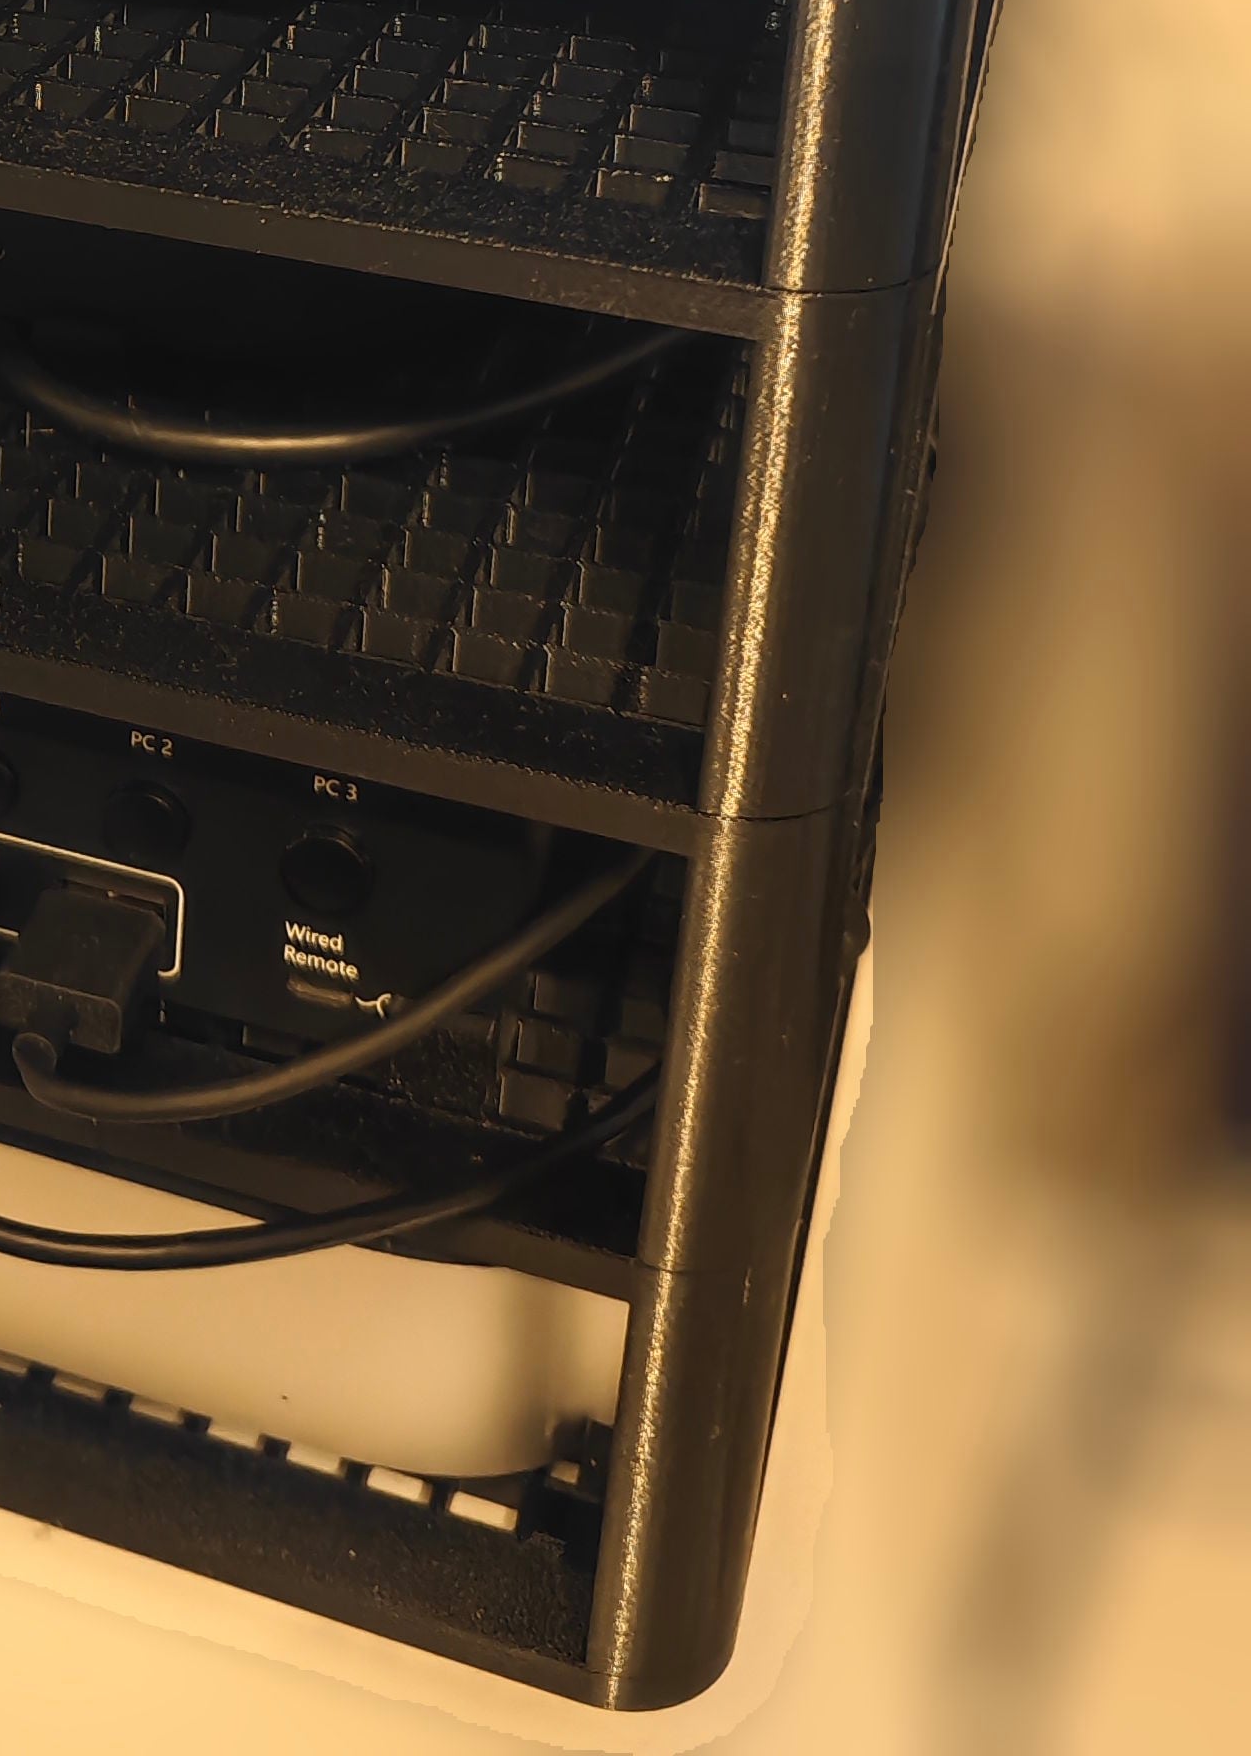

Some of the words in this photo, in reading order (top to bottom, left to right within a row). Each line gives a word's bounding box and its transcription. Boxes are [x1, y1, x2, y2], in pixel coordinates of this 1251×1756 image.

[130, 730, 157, 753] PC
[161, 739, 174, 758] 2
[313, 773, 340, 796] PC
[344, 782, 359, 803] 3
[284, 919, 346, 955] Wired
[283, 944, 360, 982] Remote
